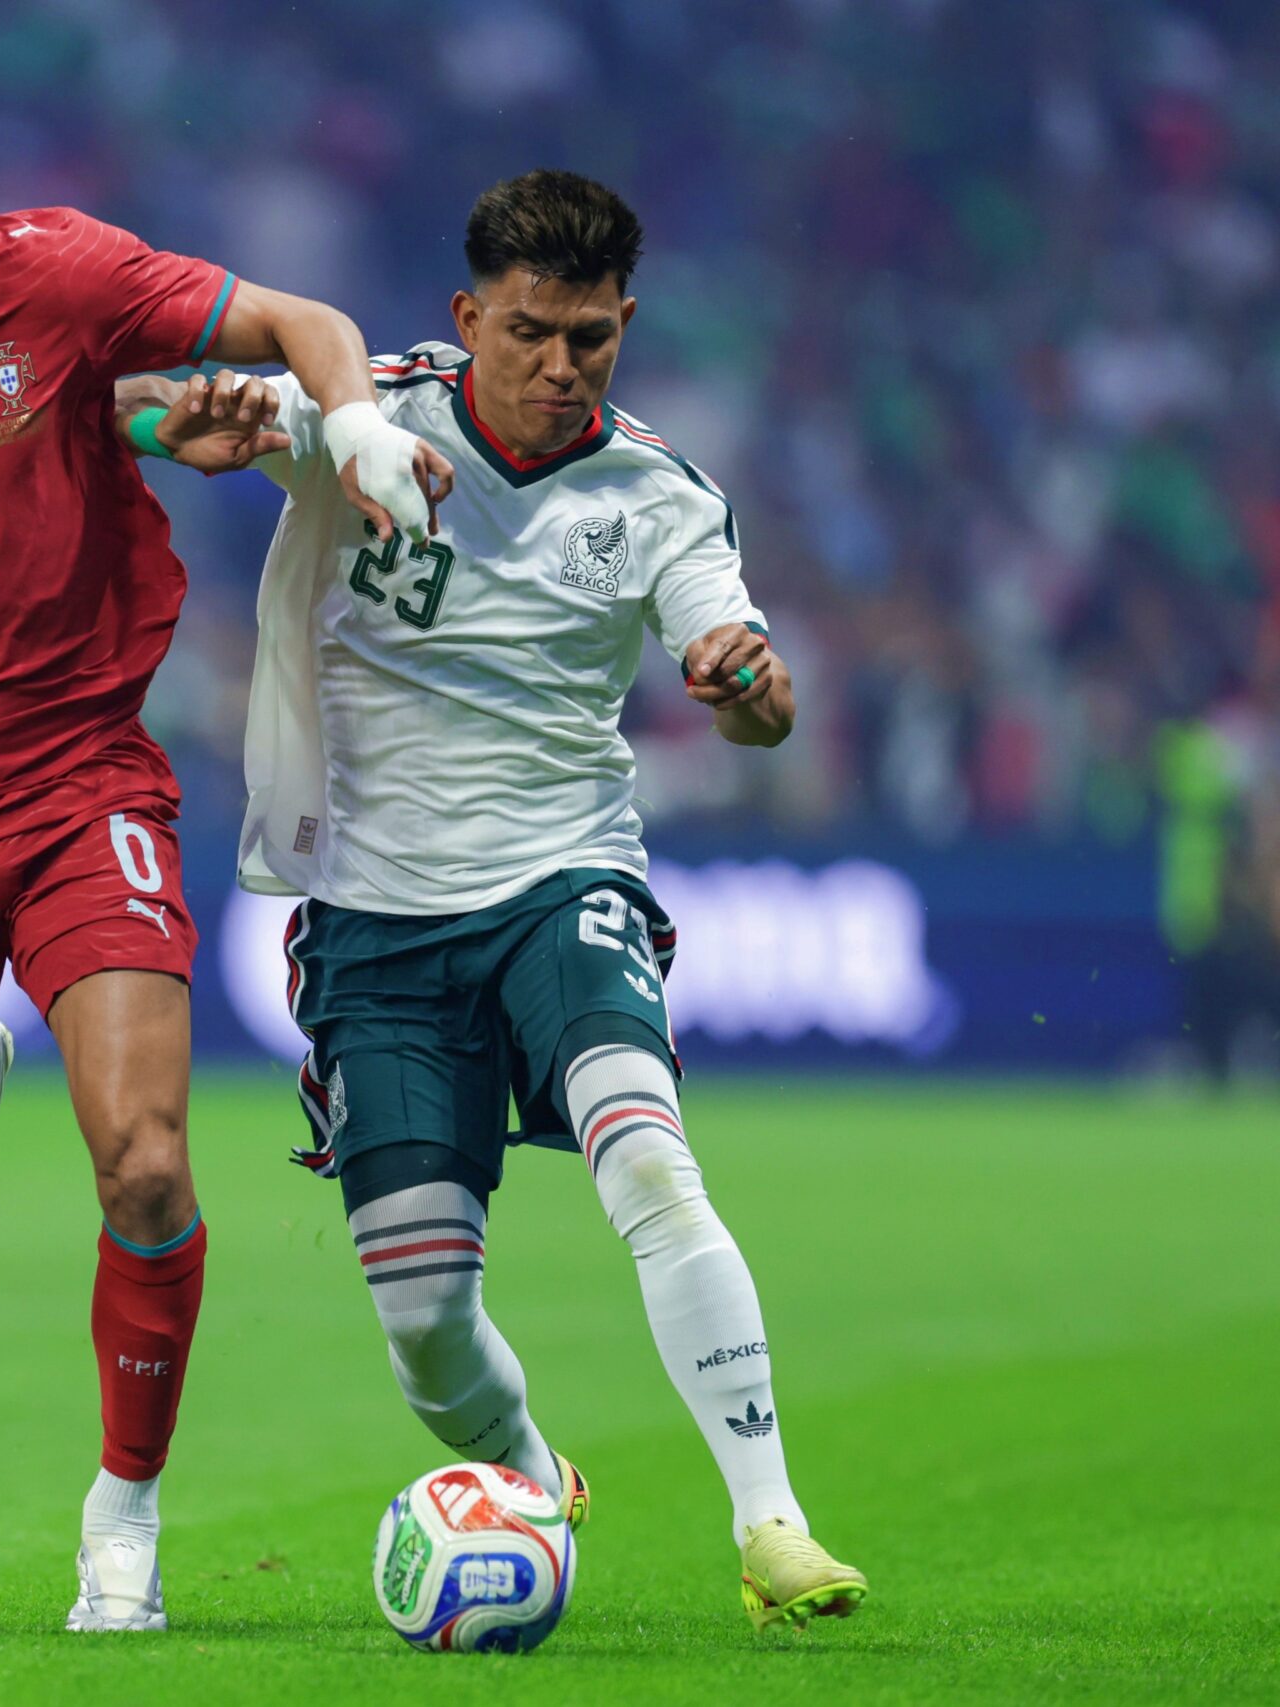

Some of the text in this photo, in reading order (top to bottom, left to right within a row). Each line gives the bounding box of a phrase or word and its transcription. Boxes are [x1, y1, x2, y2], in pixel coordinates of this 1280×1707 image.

[350, 518, 456, 632] 23
[563, 571, 615, 593] MÉXICO
[109, 813, 162, 893] 6
[579, 889, 658, 982] 23
[696, 1342, 768, 1373] MÉXICO
